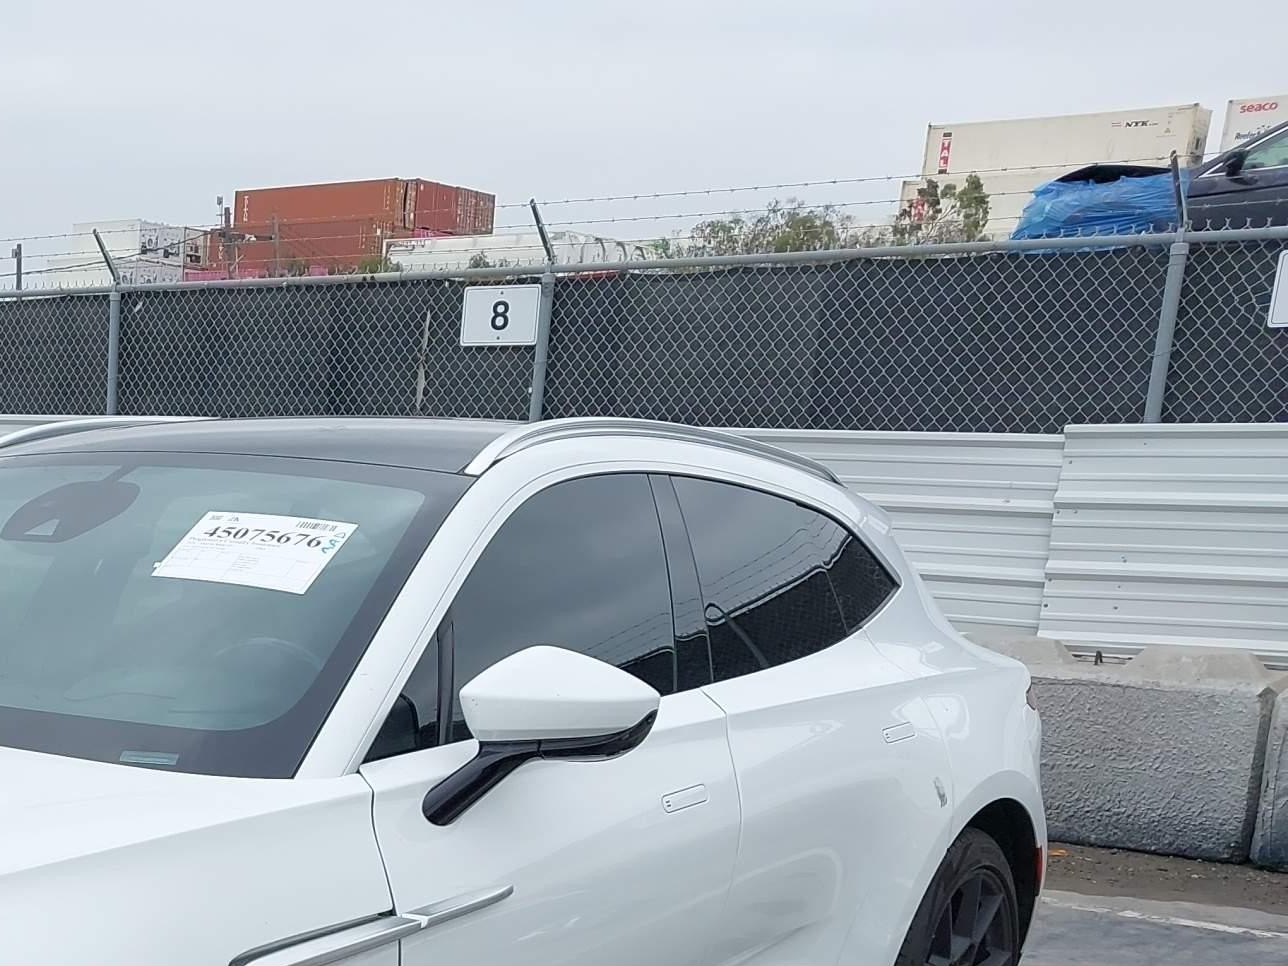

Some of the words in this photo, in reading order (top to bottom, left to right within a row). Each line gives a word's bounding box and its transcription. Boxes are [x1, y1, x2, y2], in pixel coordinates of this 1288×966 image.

[1239, 102, 1278, 114] seaco
[490, 300, 510, 331] 8
[203, 526, 327, 548] 45075676
